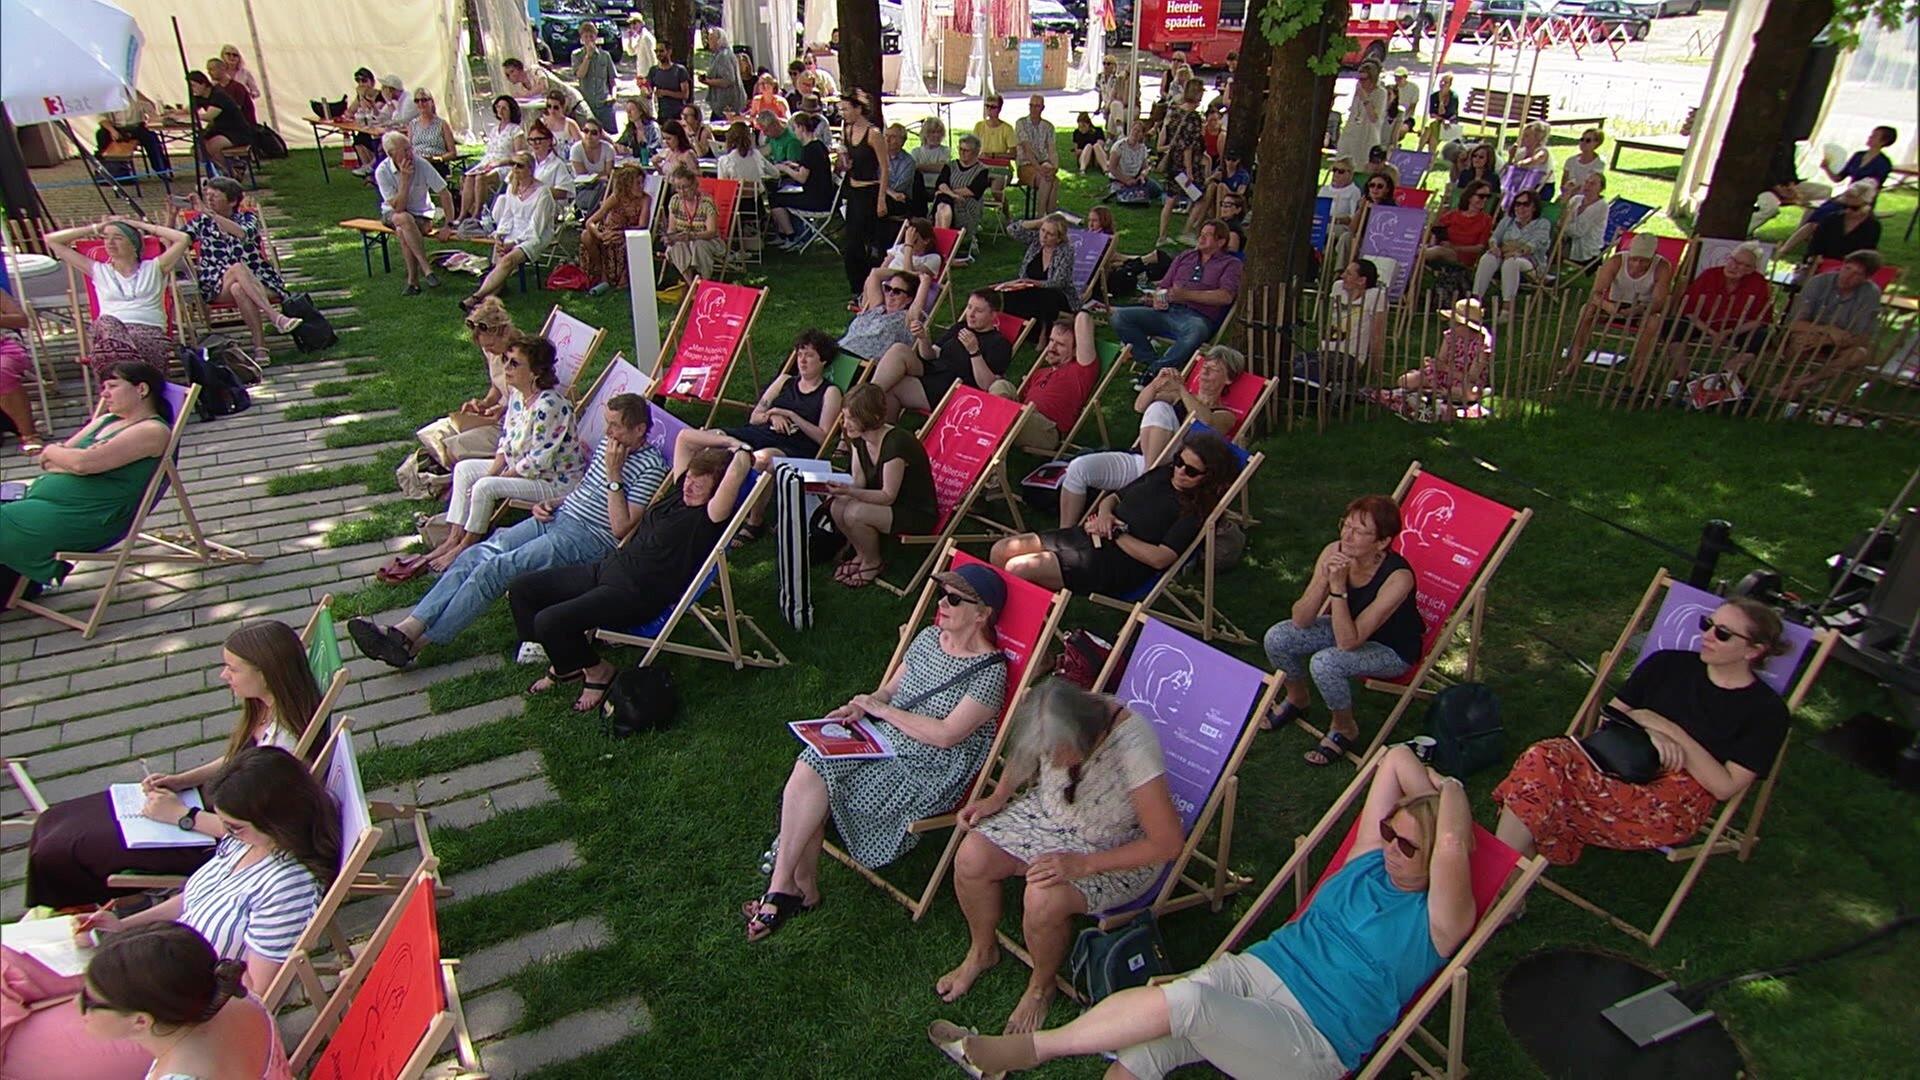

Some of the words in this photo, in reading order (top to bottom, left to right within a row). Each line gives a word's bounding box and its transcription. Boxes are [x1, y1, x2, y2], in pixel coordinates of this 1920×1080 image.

[1166, 1, 1202, 14] Herein-
[1164, 14, 1206, 31] spaziert.
[44, 95, 93, 116] 3sat
